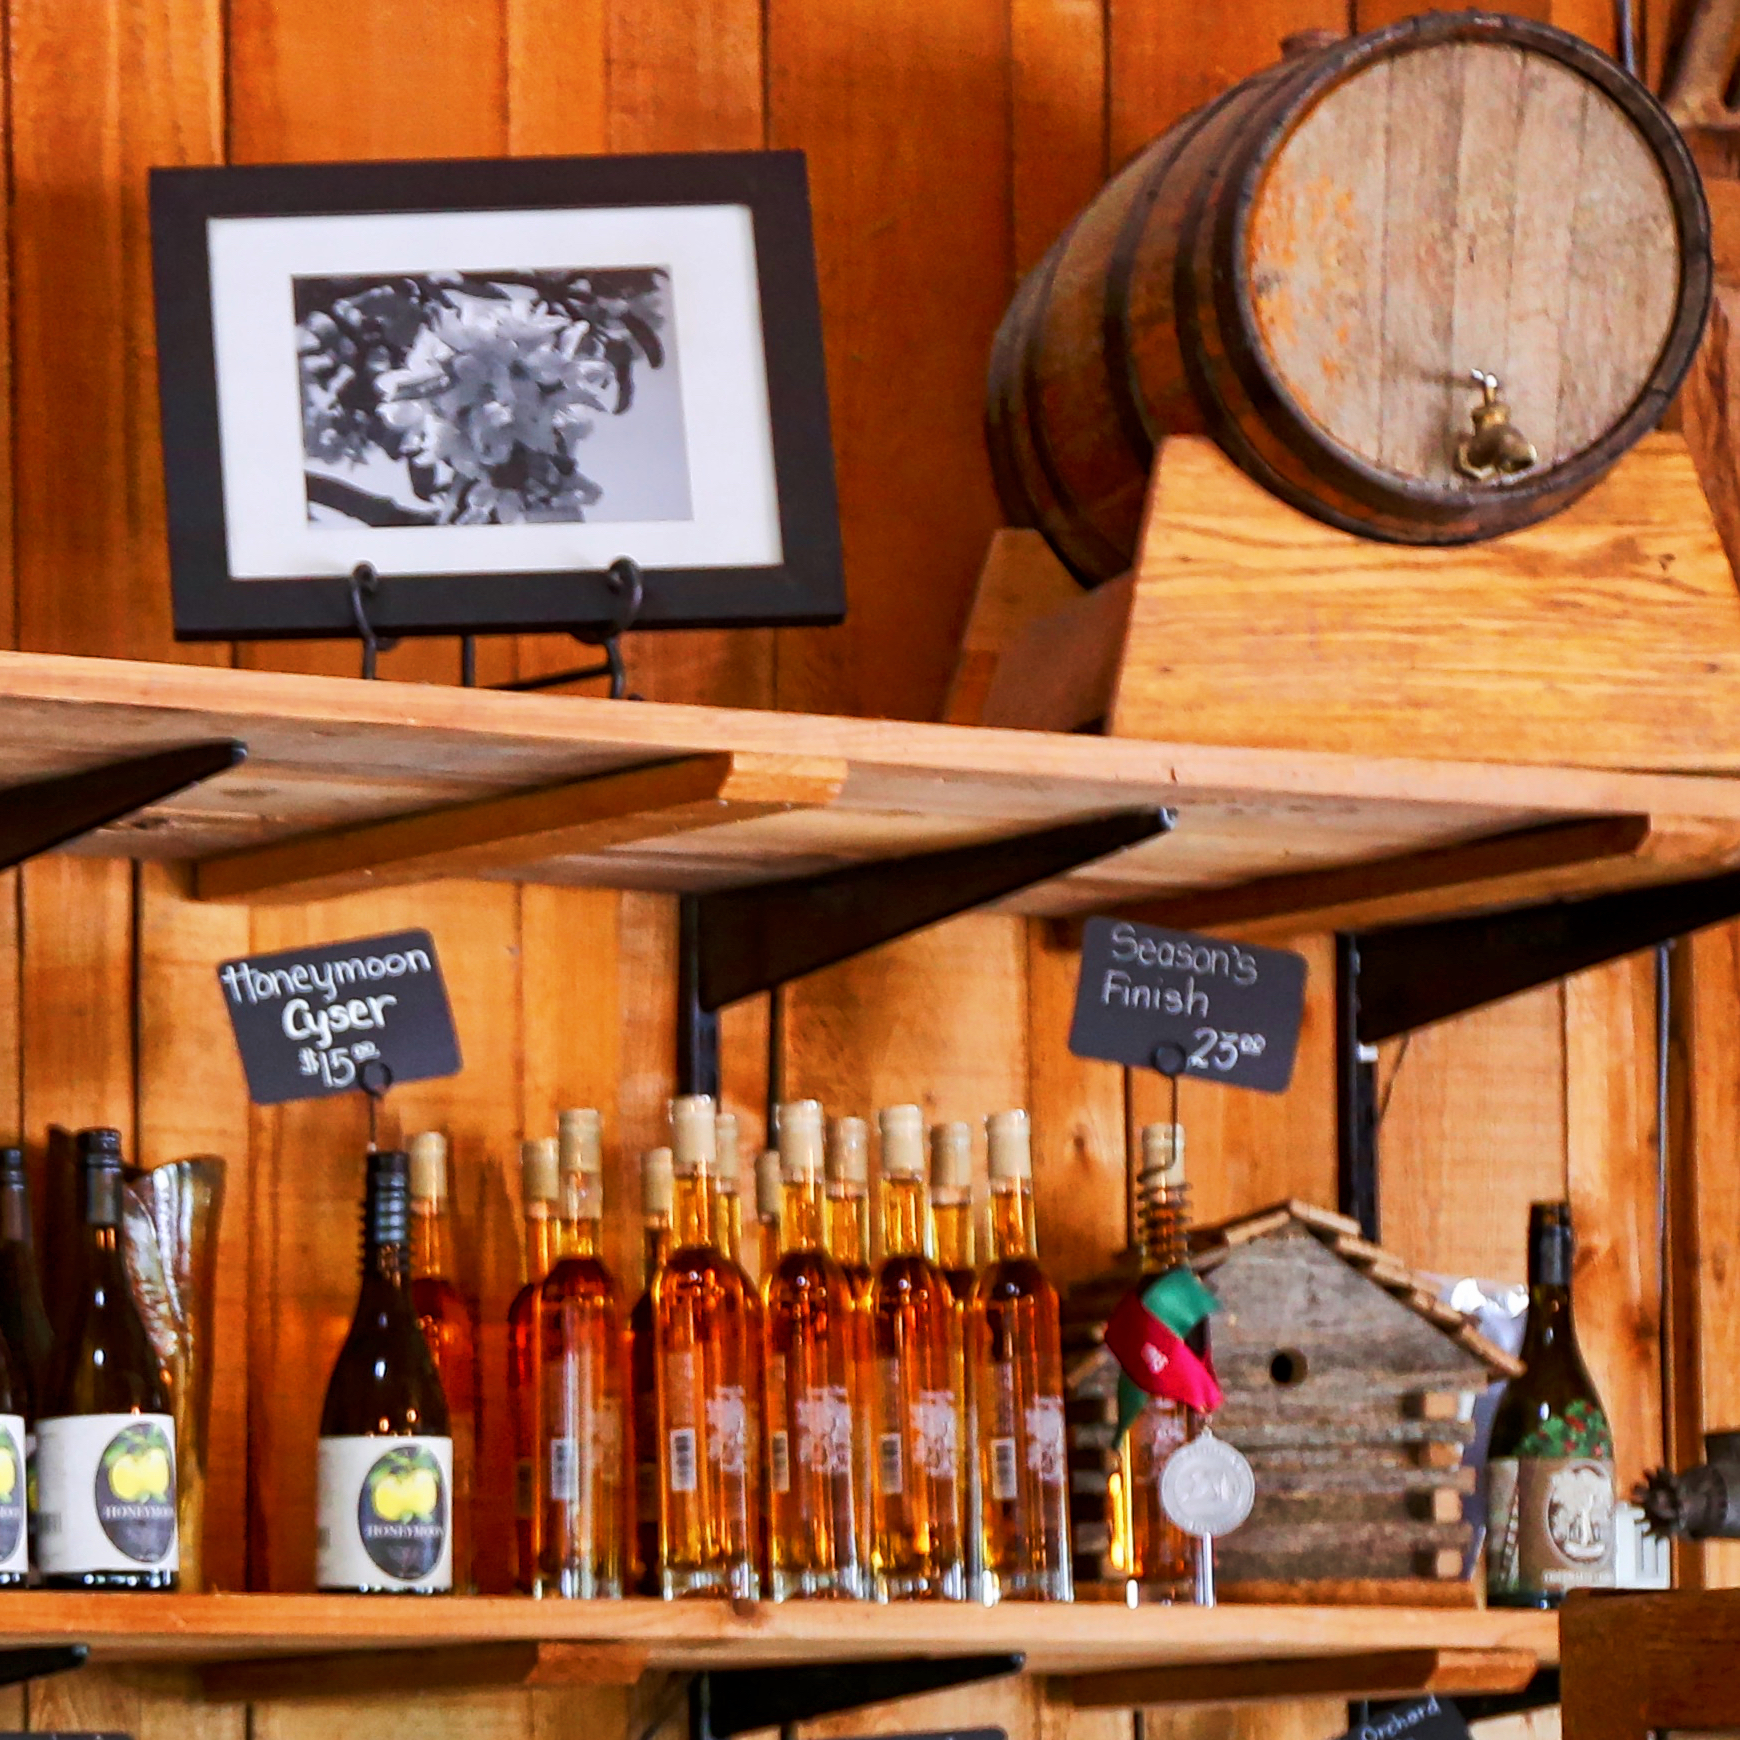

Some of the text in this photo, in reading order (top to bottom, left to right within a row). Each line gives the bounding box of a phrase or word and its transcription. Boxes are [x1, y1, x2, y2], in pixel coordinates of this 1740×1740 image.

[221, 949, 432, 1005] Honeymoon
[1110, 922, 1258, 986] Season's
[1101, 968, 1210, 1019] Finish
[281, 994, 398, 1050] Cyser
[105, 1503, 175, 1519] HONEYMOO
